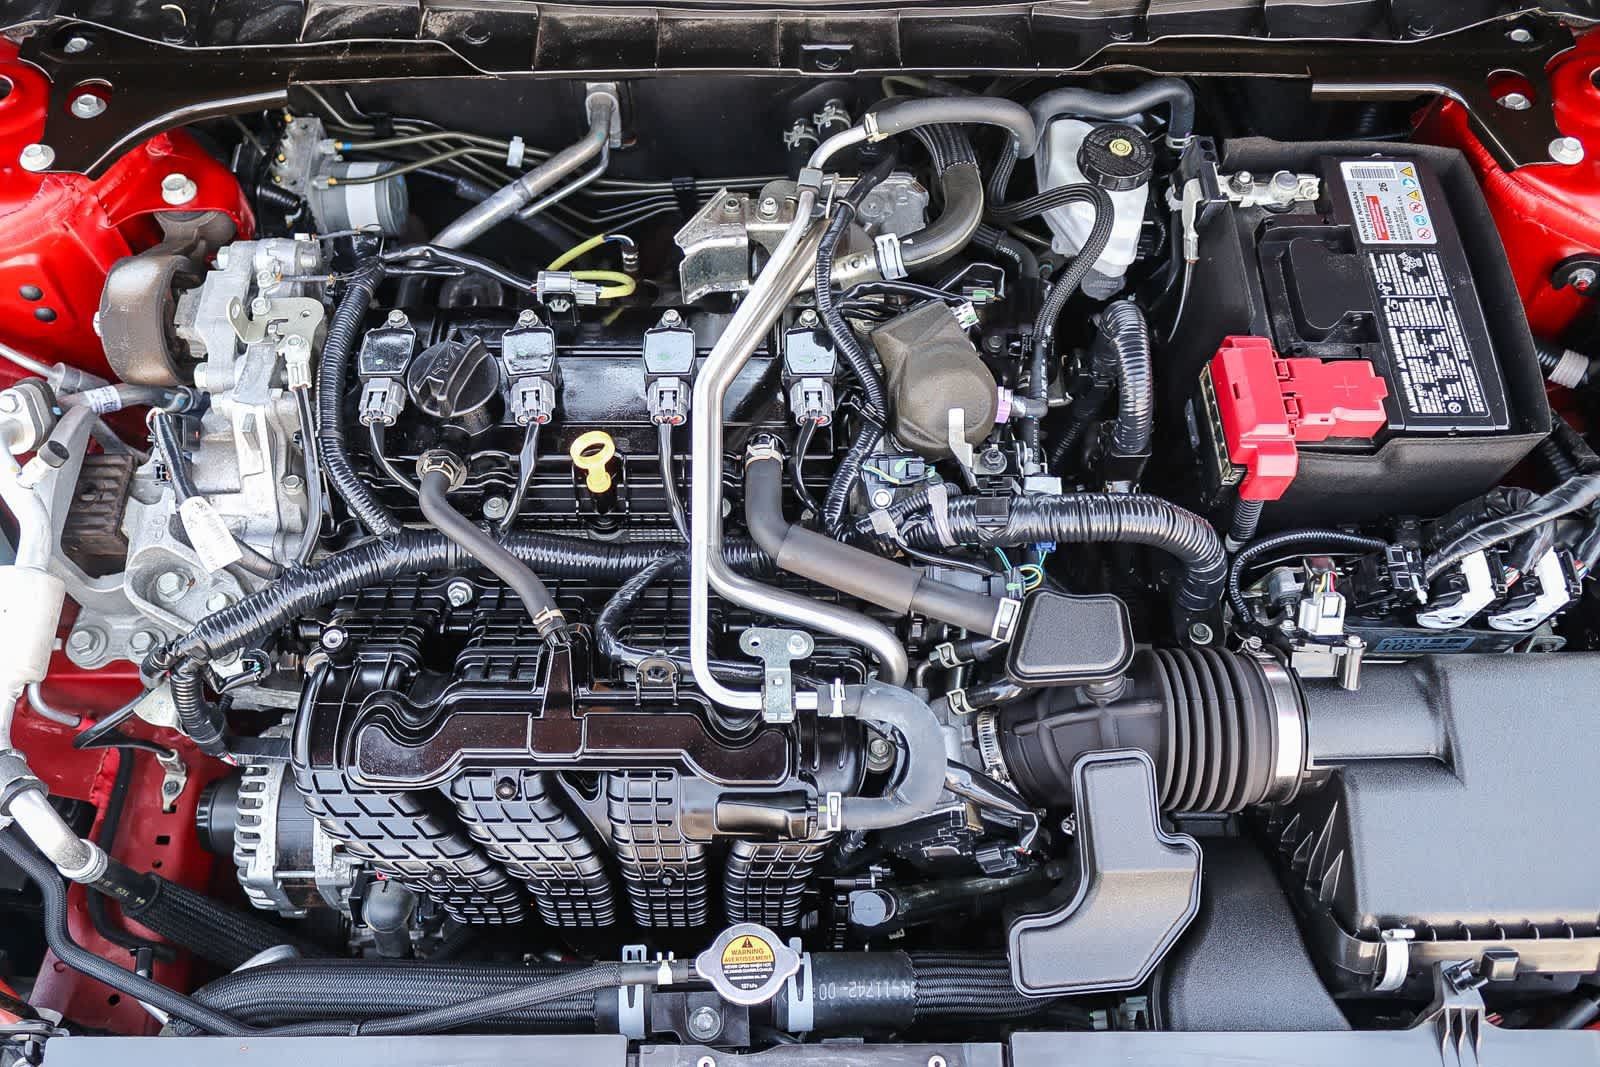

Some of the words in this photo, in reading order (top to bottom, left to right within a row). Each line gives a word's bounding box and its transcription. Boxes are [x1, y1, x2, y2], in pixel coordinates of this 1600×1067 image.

[1378, 182, 1388, 192] 26
[1352, 191, 1363, 215] NISSAN
[1359, 216, 1370, 240] RENAULT
